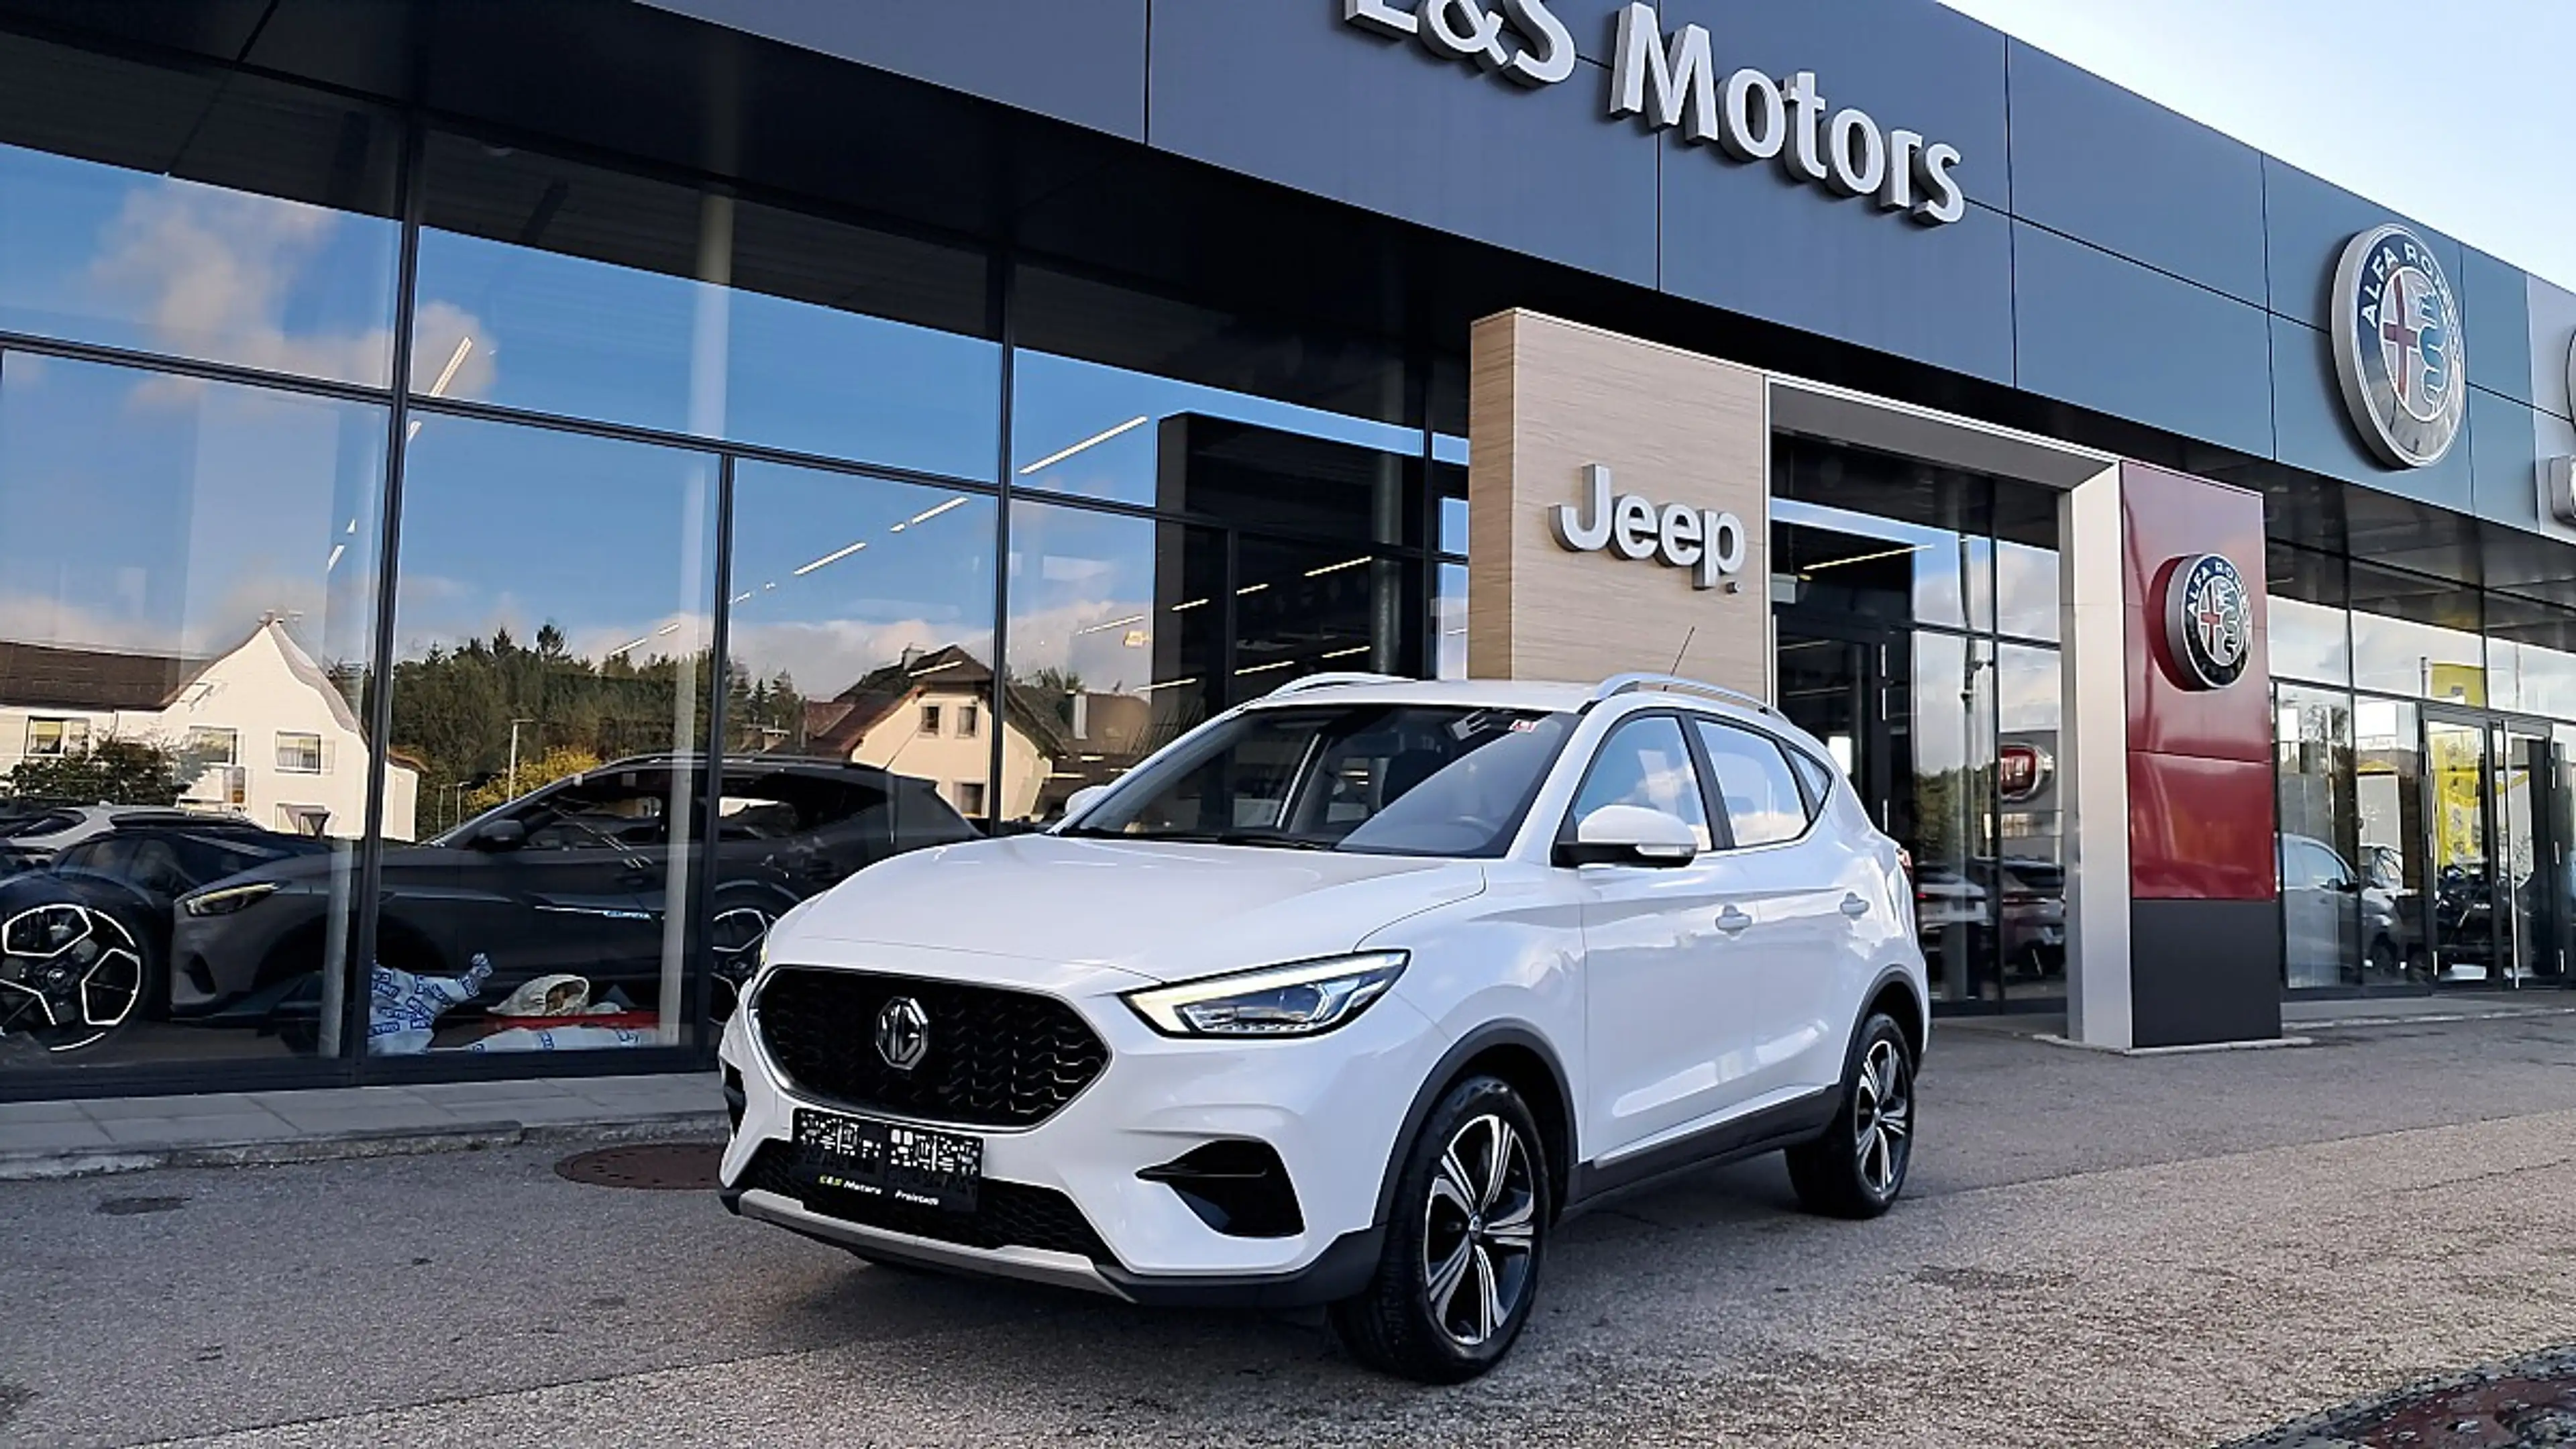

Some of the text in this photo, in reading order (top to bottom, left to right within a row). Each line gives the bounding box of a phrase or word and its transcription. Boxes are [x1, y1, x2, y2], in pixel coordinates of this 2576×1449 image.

[1344, 0, 1965, 225] &S Motors
[2361, 246, 2399, 328] ALFA
[1548, 463, 1744, 590] Jeep
[2188, 567, 2210, 616] ALFA
